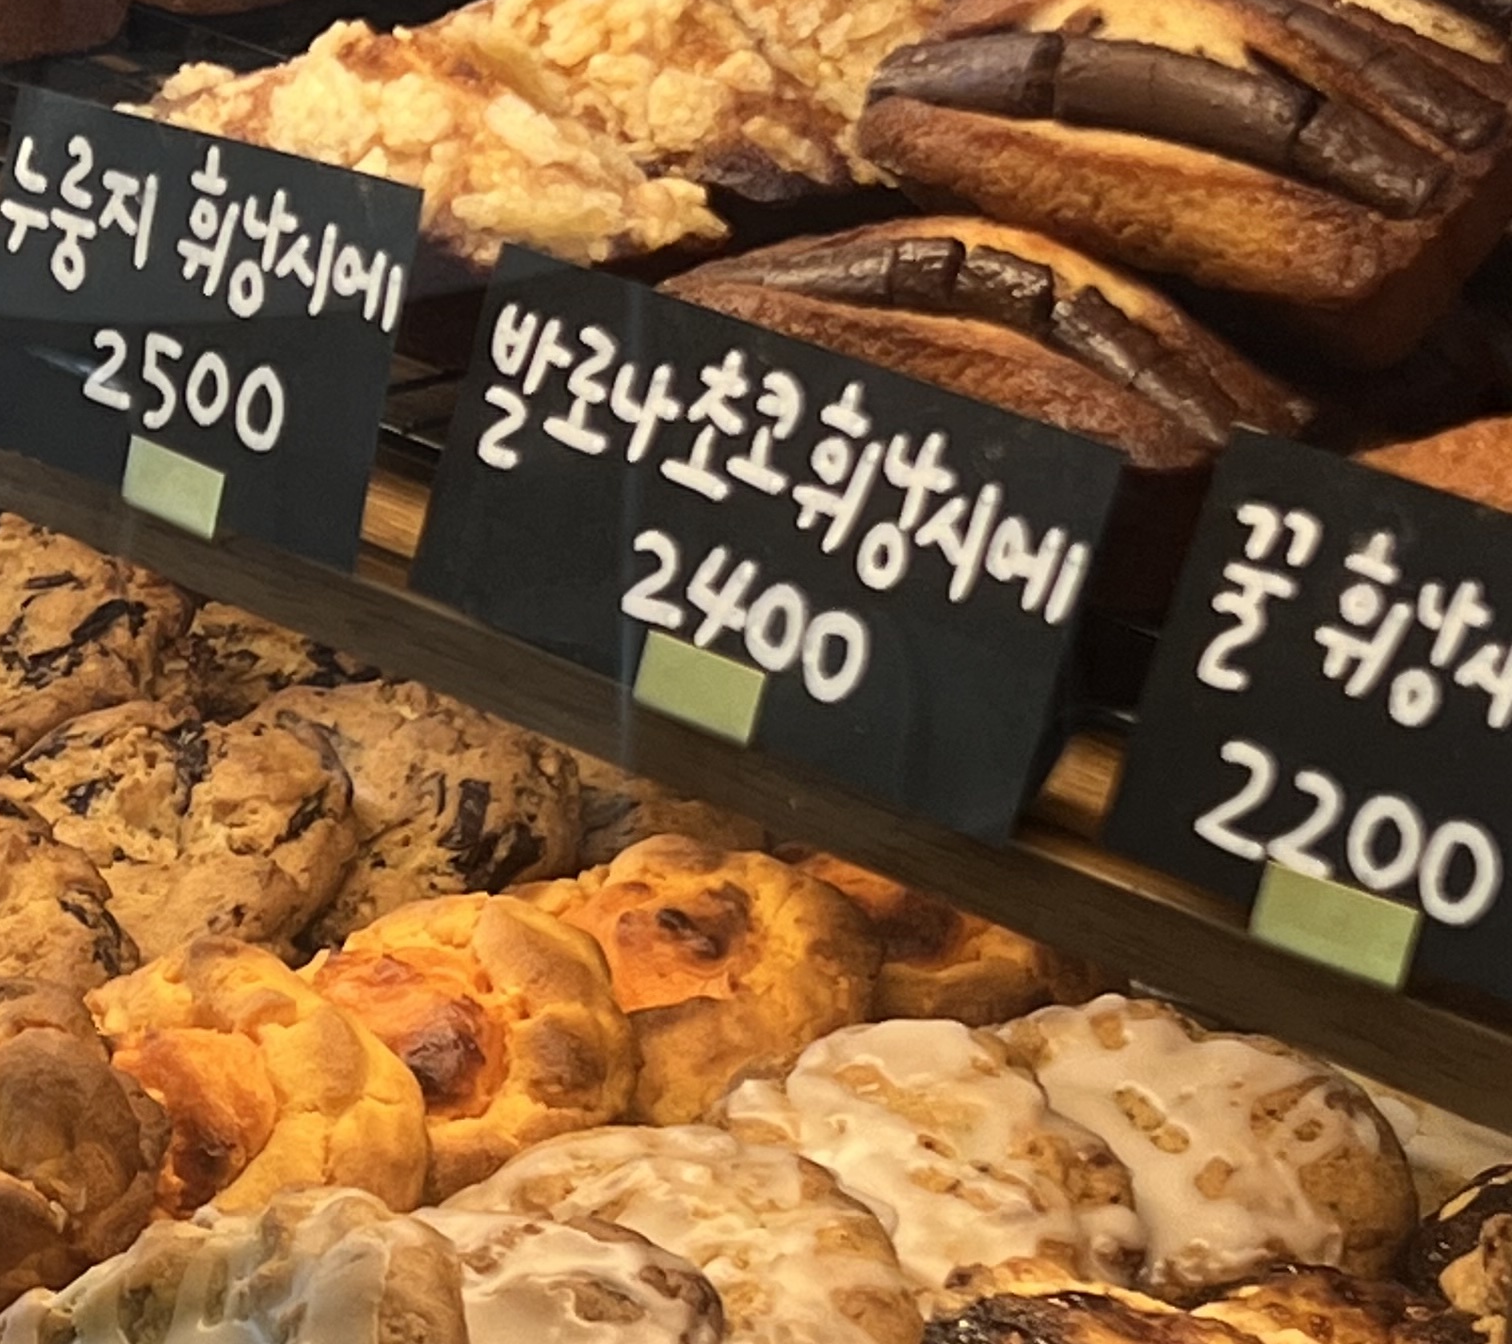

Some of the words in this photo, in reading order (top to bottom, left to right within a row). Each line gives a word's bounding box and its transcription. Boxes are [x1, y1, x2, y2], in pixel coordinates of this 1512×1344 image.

[0, 134, 159, 292] 누룽지
[176, 146, 404, 332] 휘낭시에
[83, 328, 285, 452] 2500
[621, 529, 870, 704] 2400
[1197, 503, 1324, 692] 꿀
[1193, 740, 1501, 926] 2200
